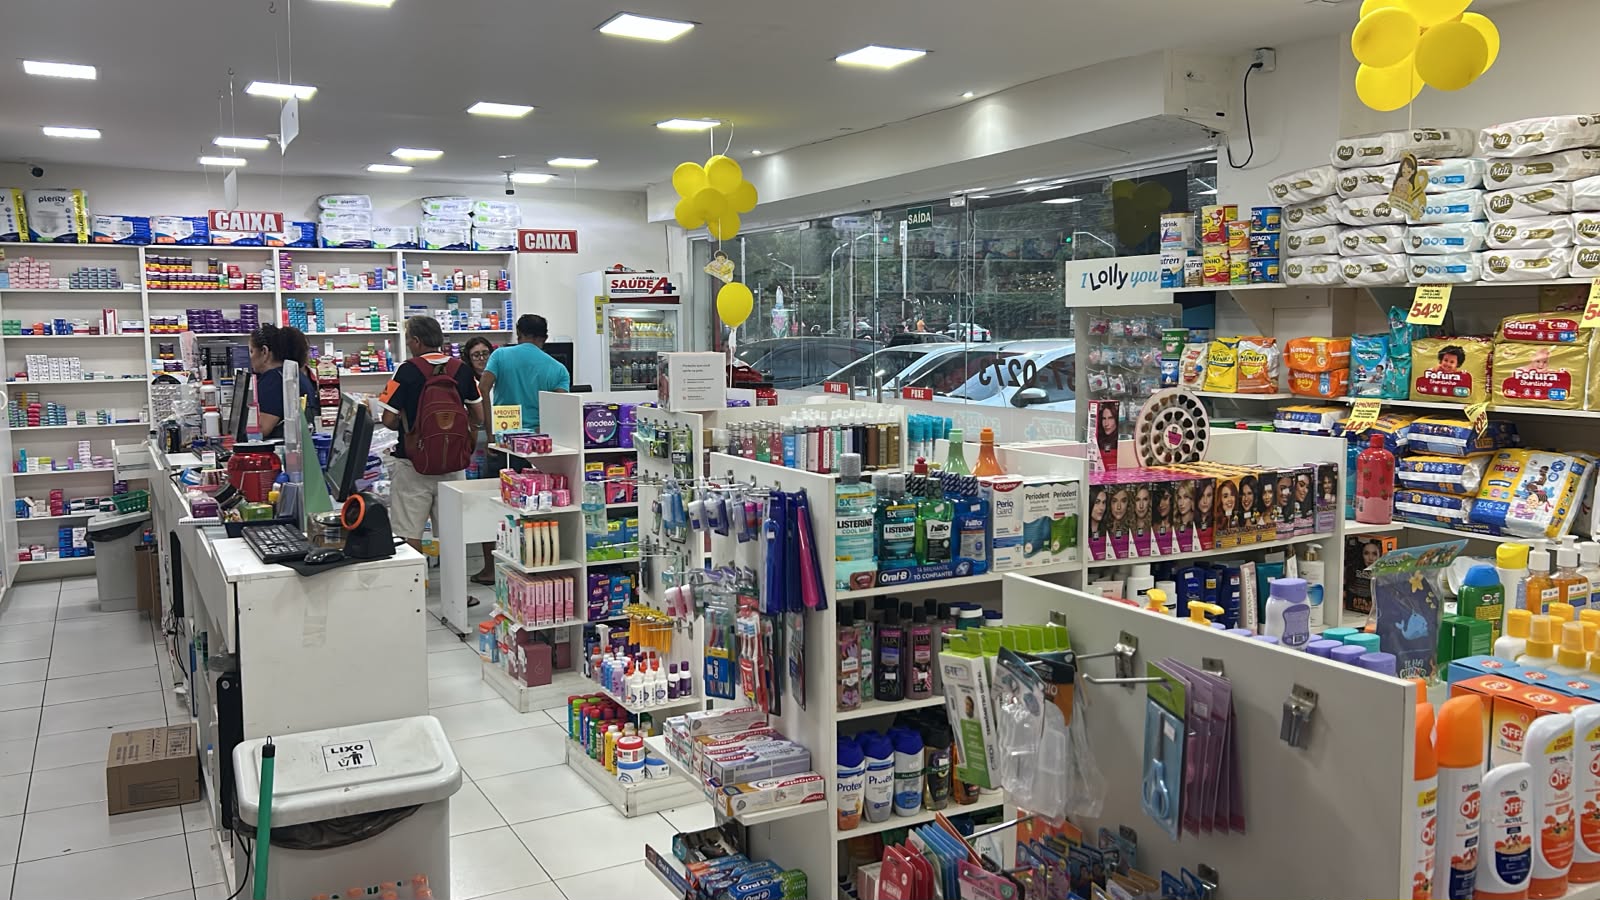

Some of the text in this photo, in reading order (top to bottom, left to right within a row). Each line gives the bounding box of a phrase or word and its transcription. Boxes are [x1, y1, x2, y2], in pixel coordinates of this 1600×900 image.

[1491, 166, 1511, 176] Mili
[38, 195, 66, 203] plenty
[1491, 197, 1512, 209] Mili
[215, 211, 277, 232] CAIXA
[908, 210, 931, 225] SAÍDA
[1495, 227, 1515, 238] Mili
[524, 232, 571, 250] CAIXA
[1580, 252, 1600, 264] Mili
[1081, 263, 1159, 291] I Lolly you
[611, 277, 654, 289] SAÚDE
[1505, 321, 1537, 330] Fofura
[1290, 346, 1315, 354] Natural
[1424, 370, 1462, 381] Fofura
[1514, 370, 1558, 381] Fofura
[830, 383, 842, 393] PUXE
[911, 389, 924, 399] PUXE
[1025, 492, 1050, 500] Periodent
[1053, 489, 1077, 499] Periodent
[996, 500, 1014, 508] Perio
[1475, 501, 1507, 511] XXG 24
[886, 510, 897, 518] 5X
[837, 518, 873, 529] LISTERINE
[885, 525, 914, 534] LISTERINE
[881, 571, 907, 582] Oral-B
[1501, 725, 1524, 741] OFF!
[331, 745, 364, 754] LIXO
[837, 781, 863, 792] Protex
[1503, 800, 1523, 814] OFF!
[1504, 816, 1523, 824] ACTIVE
